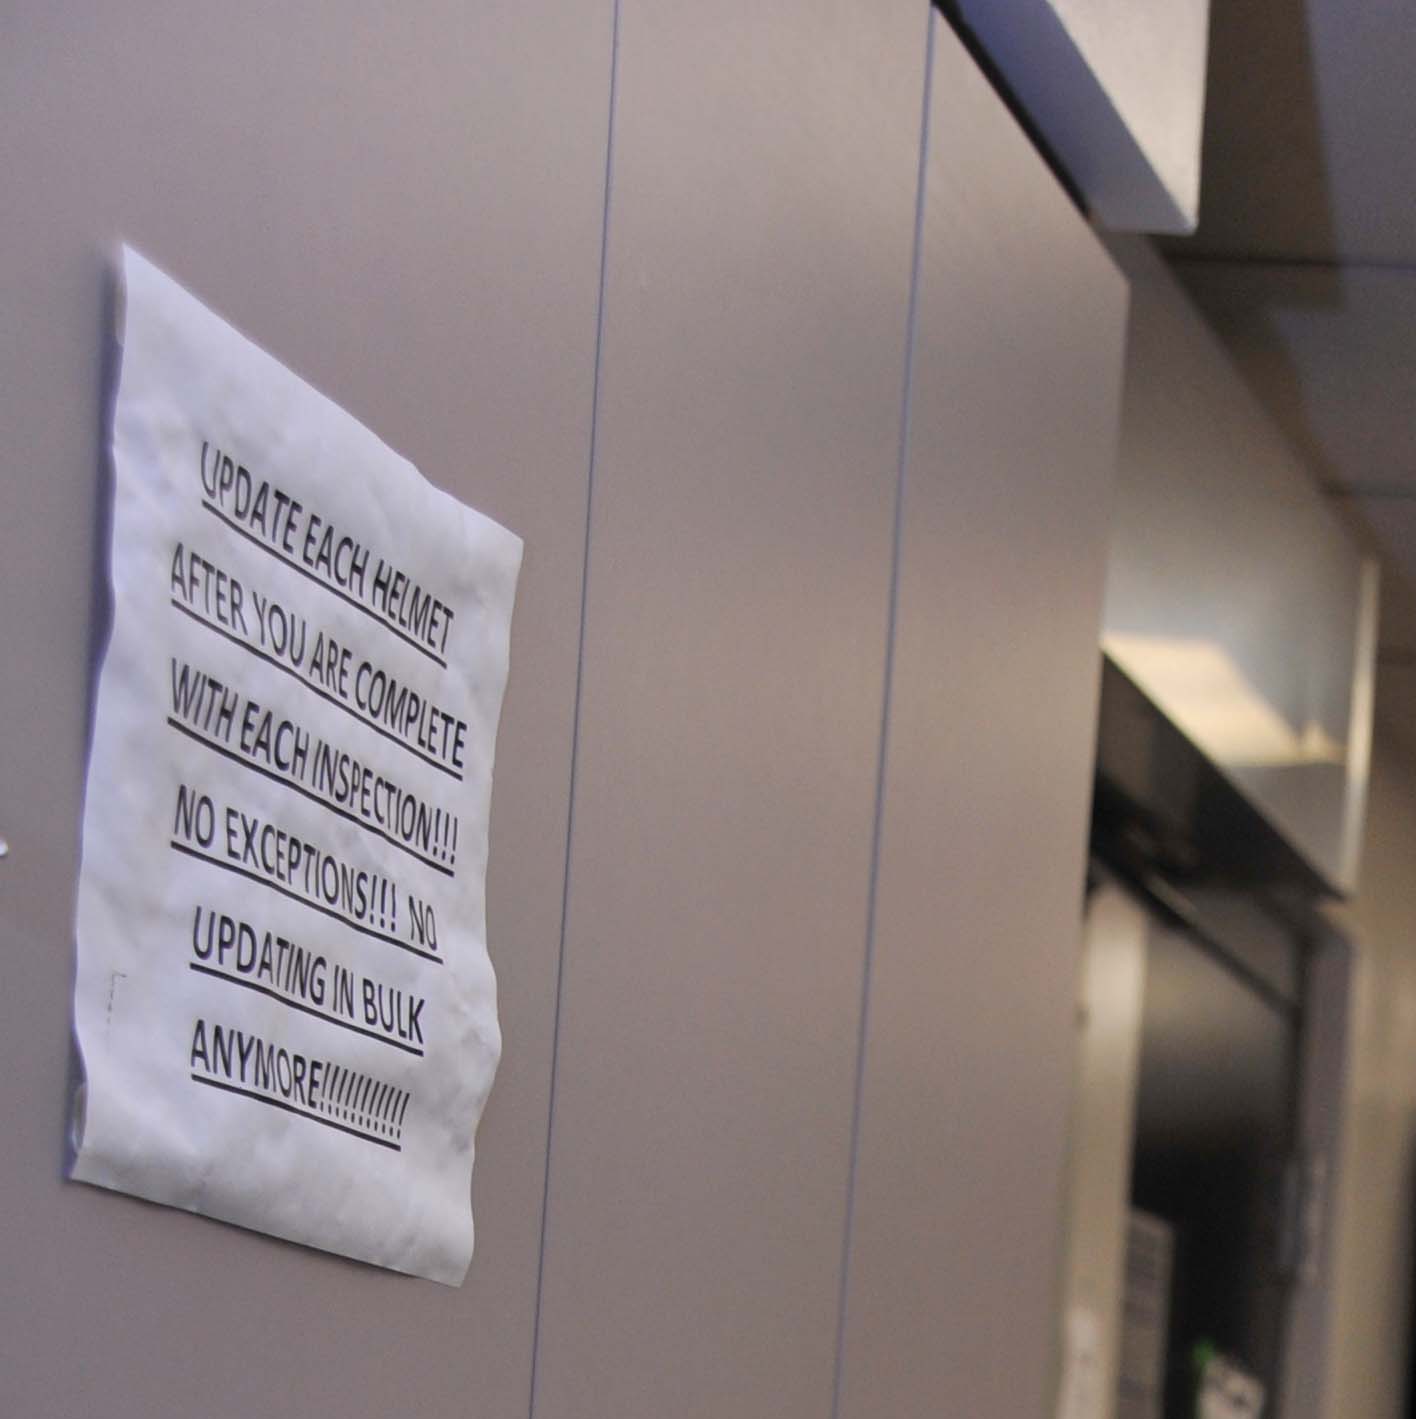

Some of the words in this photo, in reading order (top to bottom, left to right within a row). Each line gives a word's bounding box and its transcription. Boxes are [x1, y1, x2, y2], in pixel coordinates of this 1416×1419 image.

[201, 441, 302, 554] UPDATE
[303, 514, 370, 598] EACH
[372, 560, 454, 654] HELMET
[171, 543, 248, 636] AFTER
[253, 591, 306, 668] YOU
[309, 631, 352, 699] ARE
[355, 661, 467, 768] COMPLETE
[172, 657, 238, 742] WITH
[240, 701, 309, 780] EACH
[312, 740, 458, 864] INSPECTION!!!
[174, 784, 215, 848] NO
[226, 807, 396, 932] EXCEPTIONS!!!
[409, 895, 437, 951] NO
[193, 906, 327, 1005] UPDATING
[333, 965, 354, 1018] IN
[363, 978, 424, 1044] BULK
